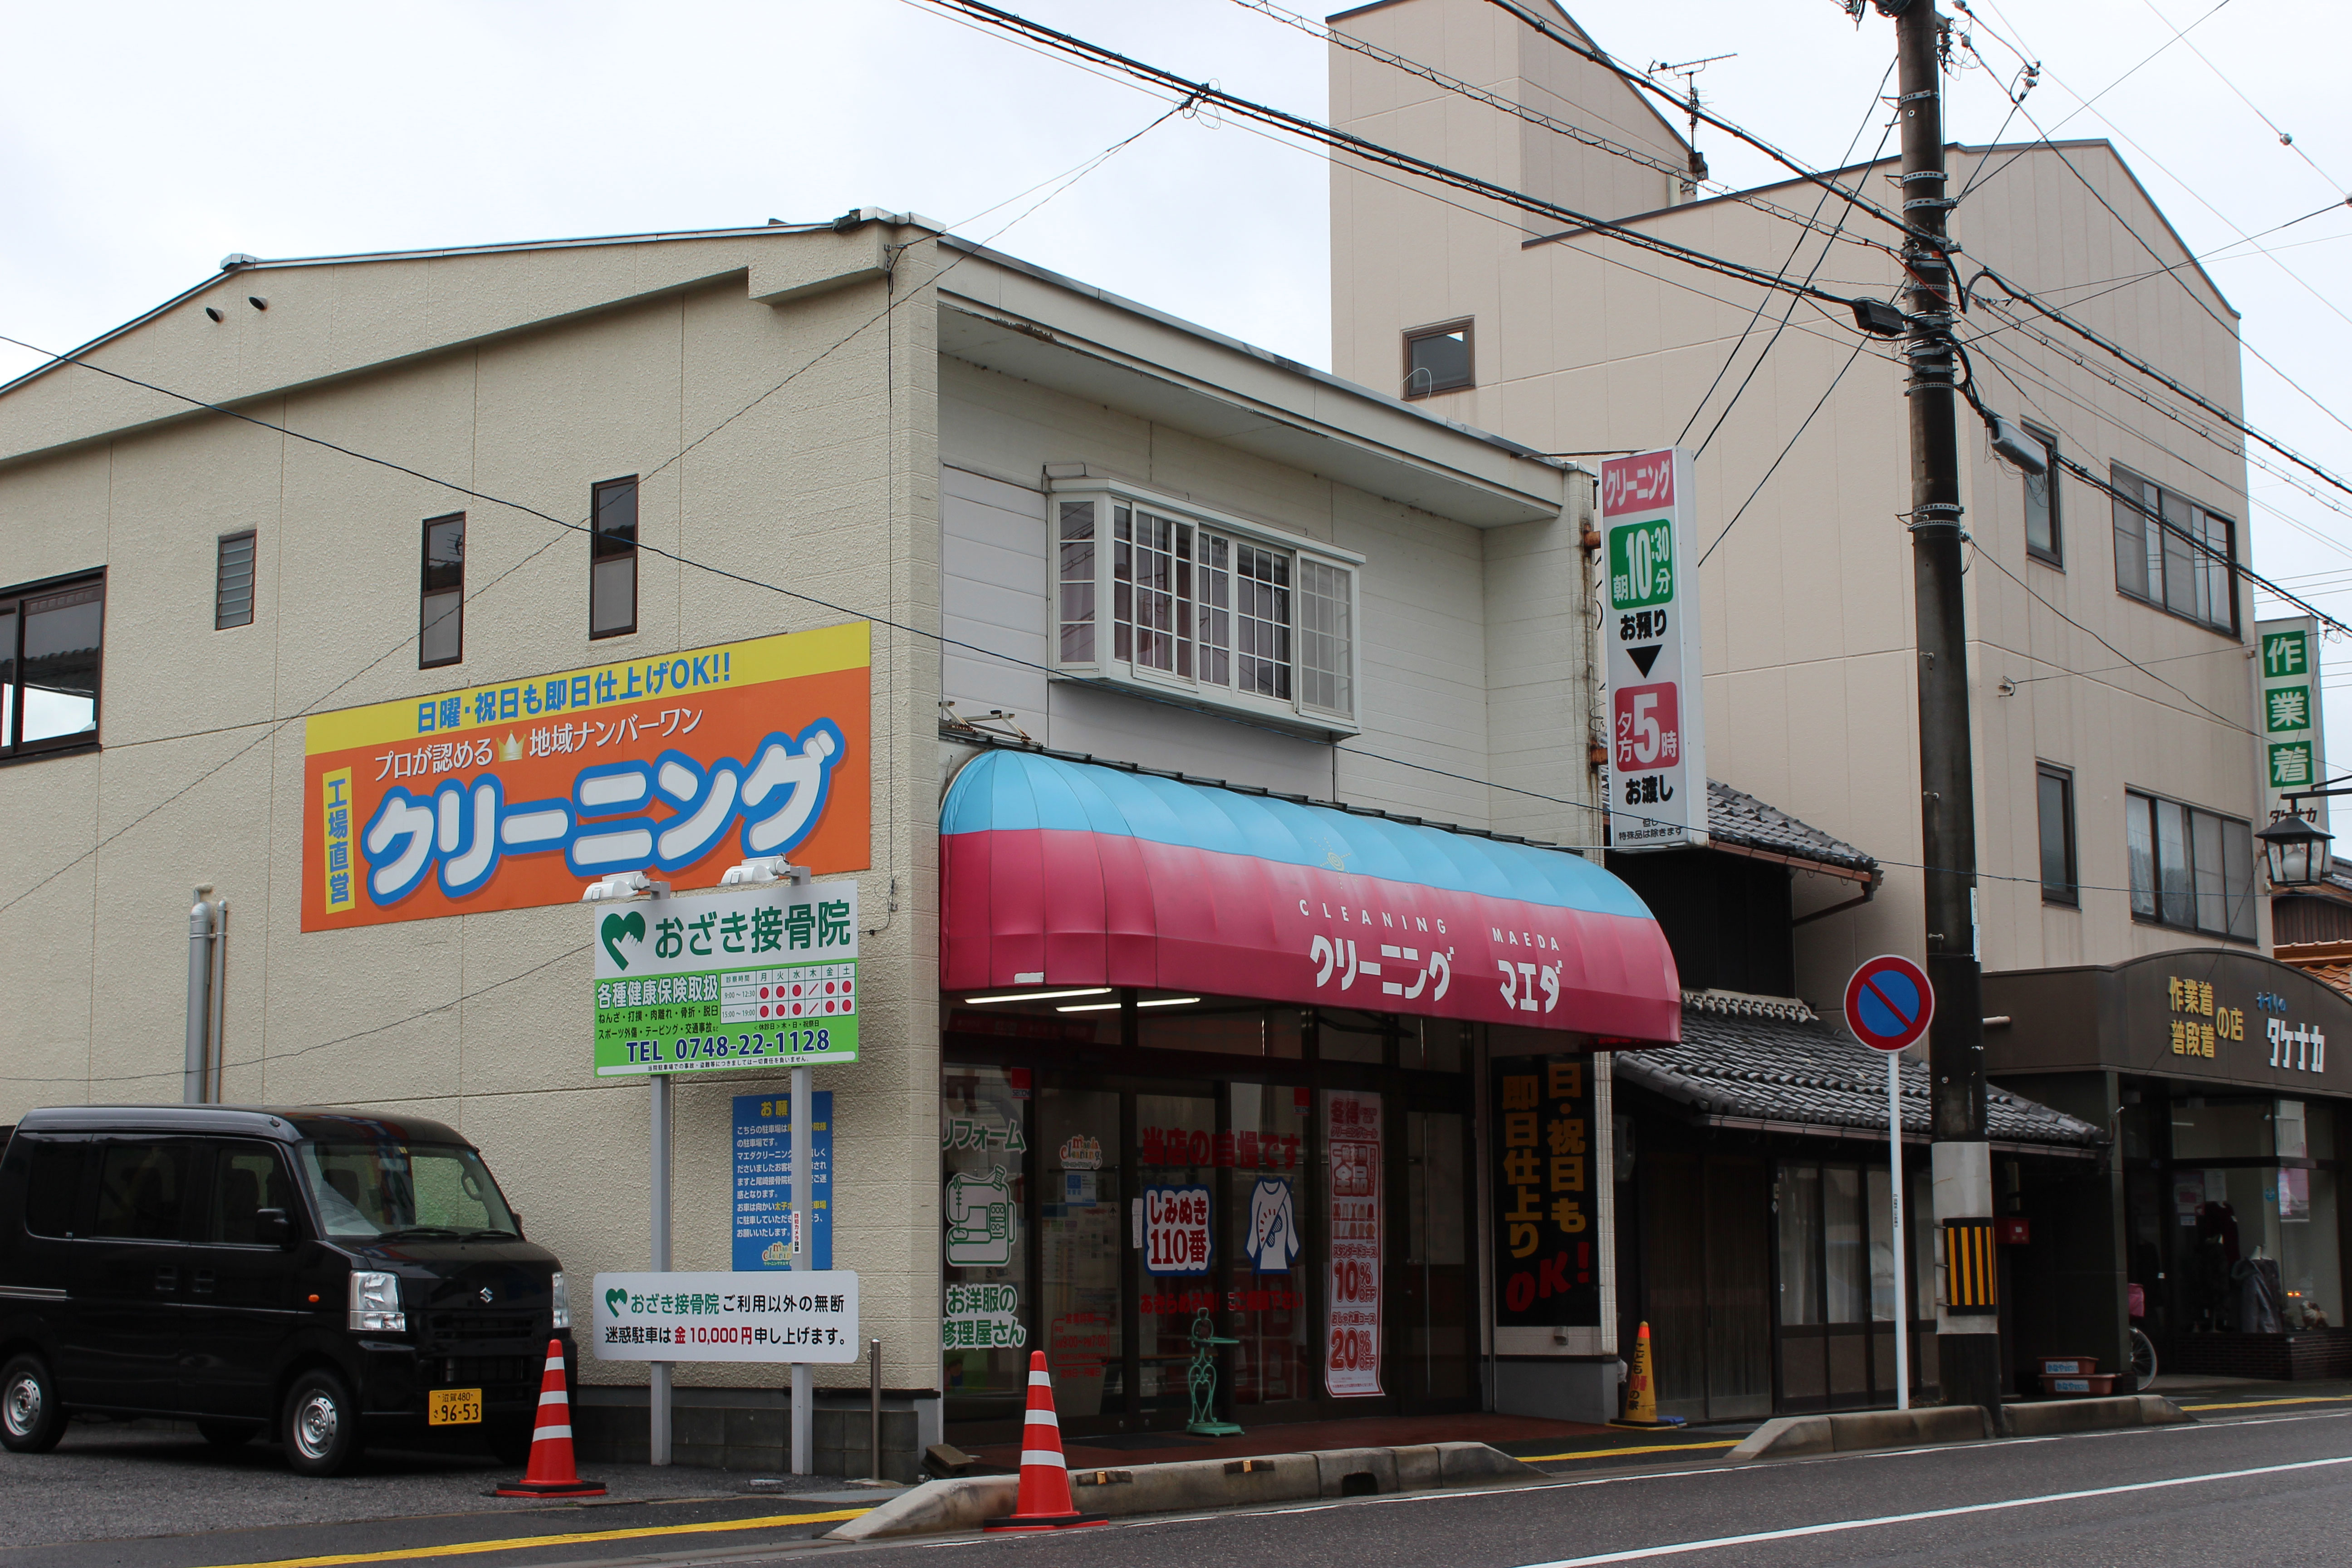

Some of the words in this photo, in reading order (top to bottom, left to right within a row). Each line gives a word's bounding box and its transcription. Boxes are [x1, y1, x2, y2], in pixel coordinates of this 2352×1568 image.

[1605, 459, 1670, 509] クリーニング
[1620, 609, 1666, 641] お預り
[417, 653, 731, 733] 日曜・祝日も即日仕上げOK!!
[2268, 637, 2308, 782] 作業着
[1625, 774, 1673, 805] お渡し
[361, 717, 845, 906] クリーニング
[1643, 818, 1658, 827] 但し
[328, 778, 350, 906] 工場直営
[1618, 827, 1682, 841] 特殊品は除きます
[655, 899, 851, 958] おざき接骨院
[1299, 899, 1446, 934] CLEANING
[1492, 927, 1560, 951] MAEDA
[597, 974, 719, 1009] 各種健康保険取扱
[726, 975, 750, 983] 診察時間
[760, 973, 767, 981] 月
[777, 971, 784, 980] 火
[793, 970, 800, 979] 水
[809, 969, 817, 977] 木
[826, 967, 833, 976] 金
[843, 966, 850, 975] 土
[1310, 935, 1455, 1001] クリーニング
[1498, 959, 1563, 1013] マエダ
[2169, 976, 2214, 1016] 作業着
[2171, 1020, 2215, 1058] 普段着
[2216, 1007, 2244, 1041] の店
[626, 1040, 663, 1063] TEL
[675, 1029, 830, 1060] 0748-22-1128
[2267, 1017, 2325, 1073] タケナカ
[737, 1138, 778, 1147] の駐車場です。
[1143, 1126, 1300, 1170] 当店の自慢です
[1547, 1063, 1587, 1233] 日・祝日も
[1502, 1075, 1543, 1259] 即日仕上り
[737, 1190, 778, 1199] 惑となります。
[1151, 1196, 1206, 1225] しみぬき
[737, 1228, 790, 1238] お願いいたします。
[1151, 1228, 1207, 1264] 110番
[1333, 1244, 1377, 1258] スタンダードコース
[1334, 1259, 1373, 1302] 10%
[1359, 1287, 1377, 1302] OFF
[1506, 1242, 1589, 1312] OK!
[947, 1286, 1015, 1313] お洋服の
[943, 1318, 1024, 1348] 修理屋さん
[1330, 1328, 1372, 1371] 20%
[1358, 1355, 1376, 1371] OFF
[441, 1403, 479, 1422] 96-53
